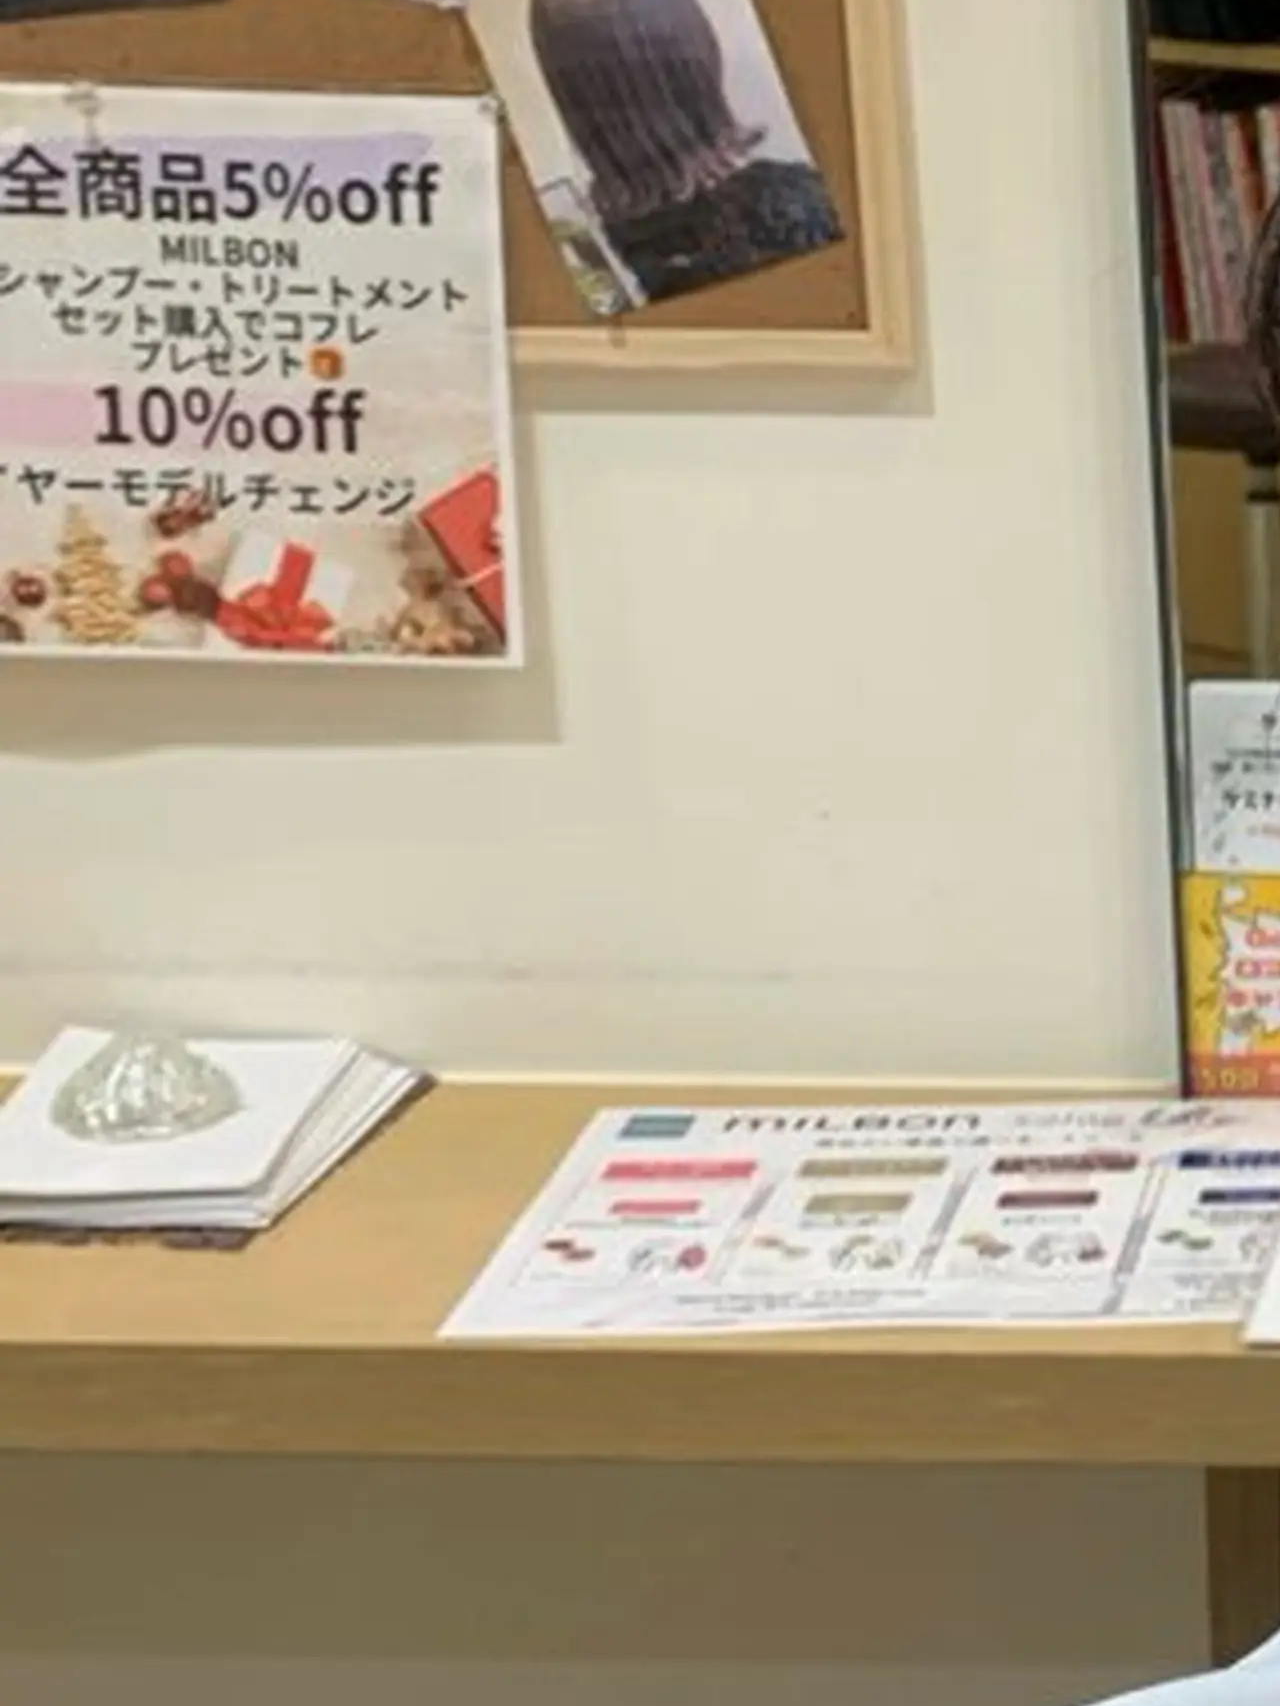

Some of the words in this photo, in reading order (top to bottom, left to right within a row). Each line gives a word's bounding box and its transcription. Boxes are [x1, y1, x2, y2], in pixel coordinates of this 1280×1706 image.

[0, 144, 442, 226] 全商品5%off
[160, 234, 300, 269] MILBON
[52, 302, 379, 346] セット購入でコフレ
[94, 385, 369, 454] 10%off
[0, 463, 417, 516] ヤーモデルチェンジ
